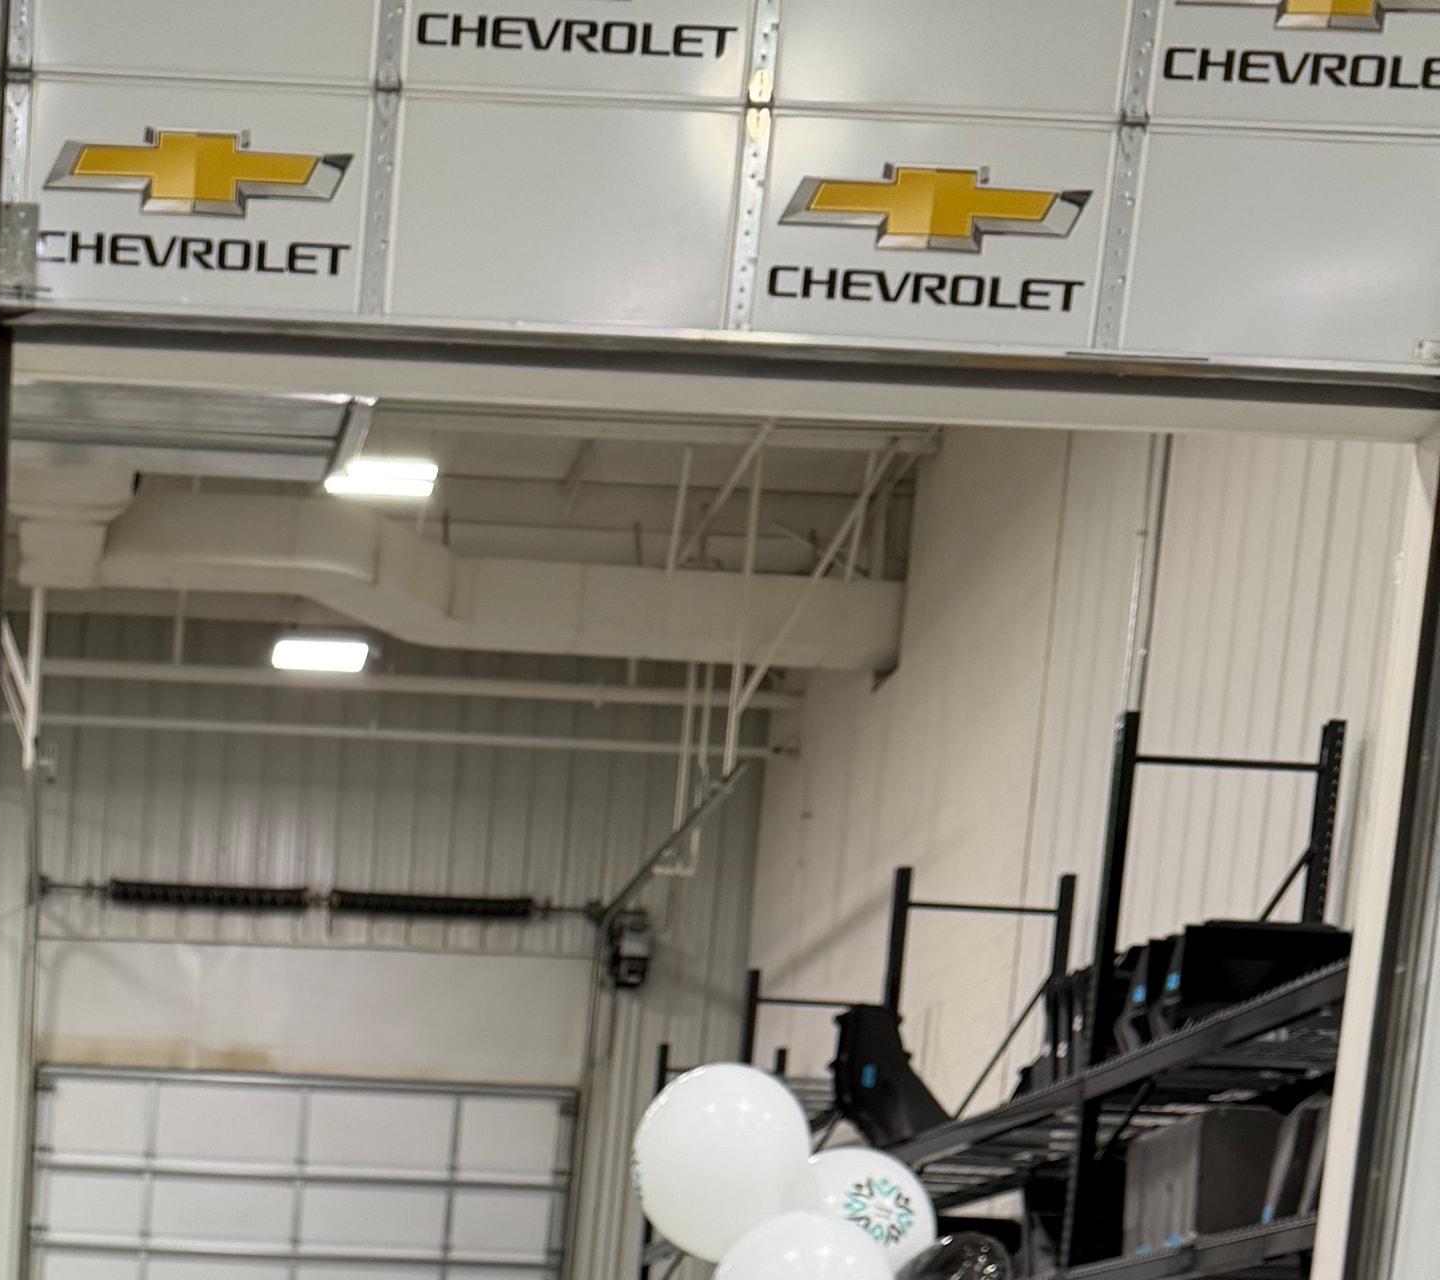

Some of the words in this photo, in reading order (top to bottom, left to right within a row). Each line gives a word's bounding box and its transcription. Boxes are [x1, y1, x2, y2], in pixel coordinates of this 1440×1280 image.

[417, 13, 738, 59] CHEVROLET
[1163, 47, 1440, 90] CHEVROLE
[37, 231, 352, 275] CHEVROLET
[768, 265, 1085, 312] CHEVROLET
